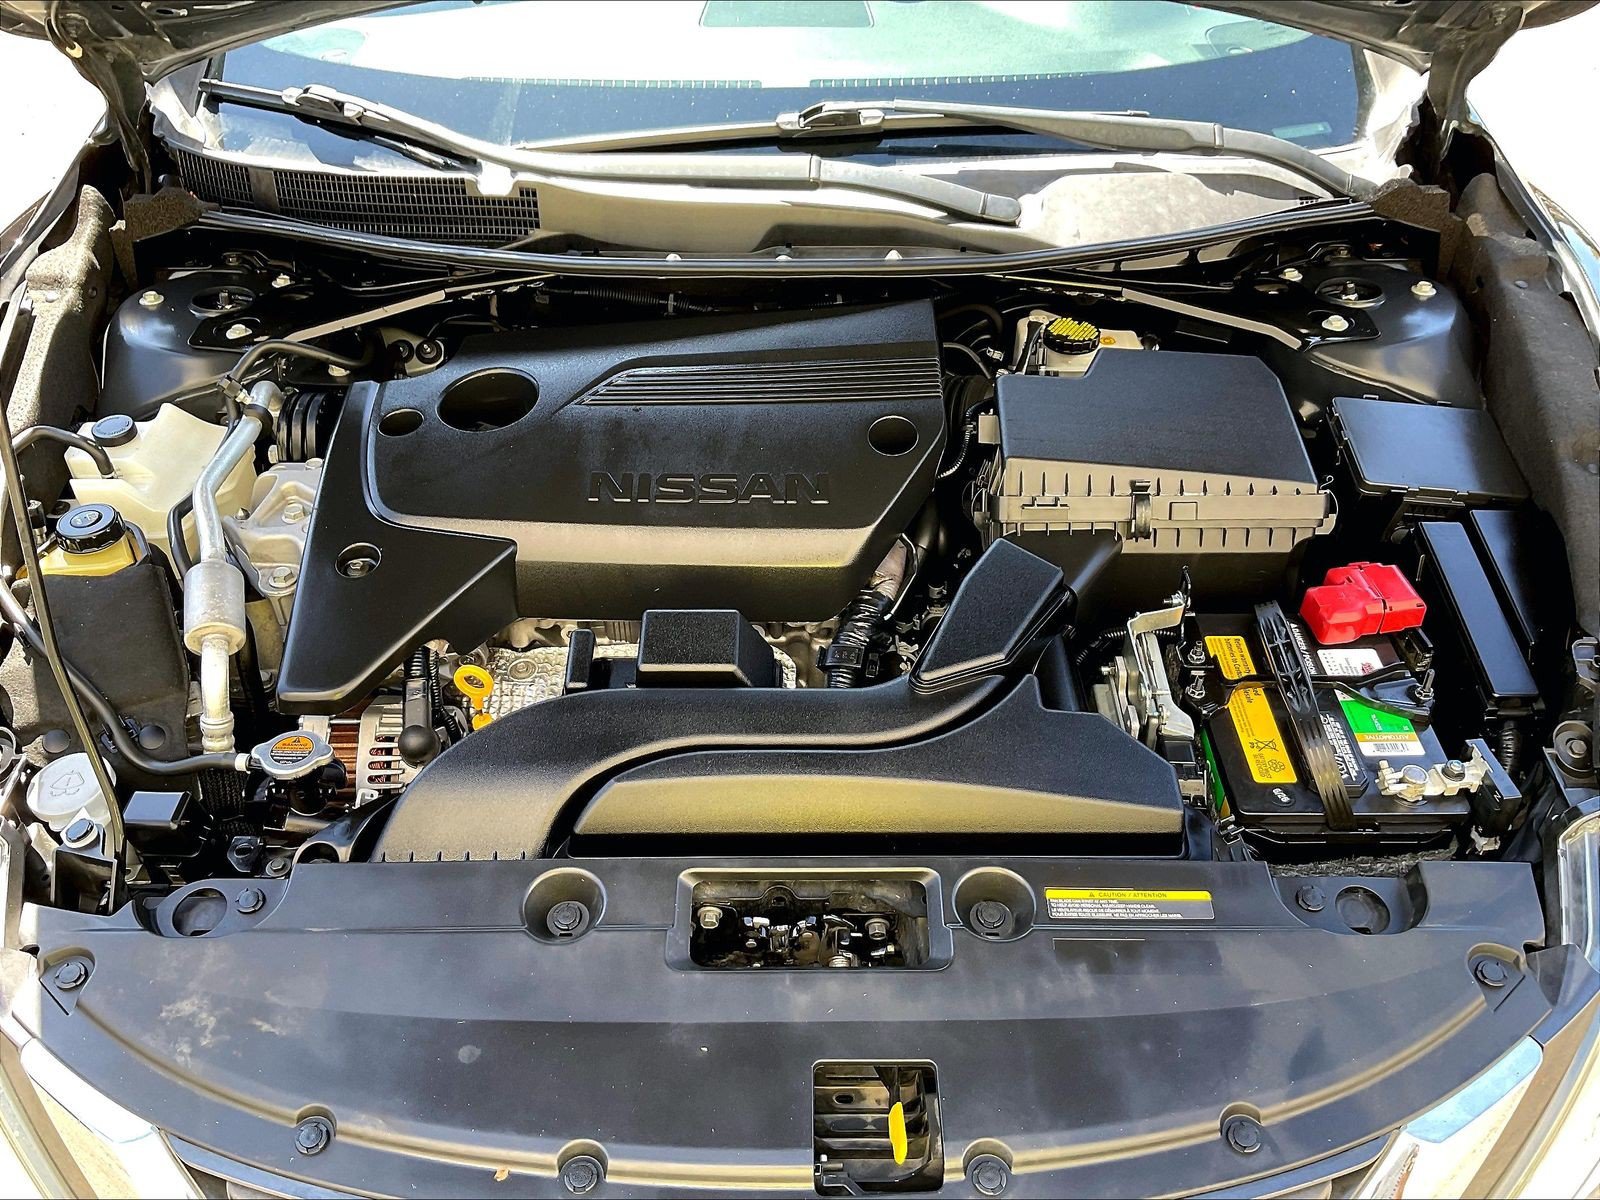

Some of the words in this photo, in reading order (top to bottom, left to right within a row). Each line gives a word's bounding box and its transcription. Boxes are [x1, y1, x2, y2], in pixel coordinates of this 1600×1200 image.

[588, 472, 829, 504] NISSAN
[1234, 638, 1243, 654] Return
[1240, 653, 1251, 673] warranty
